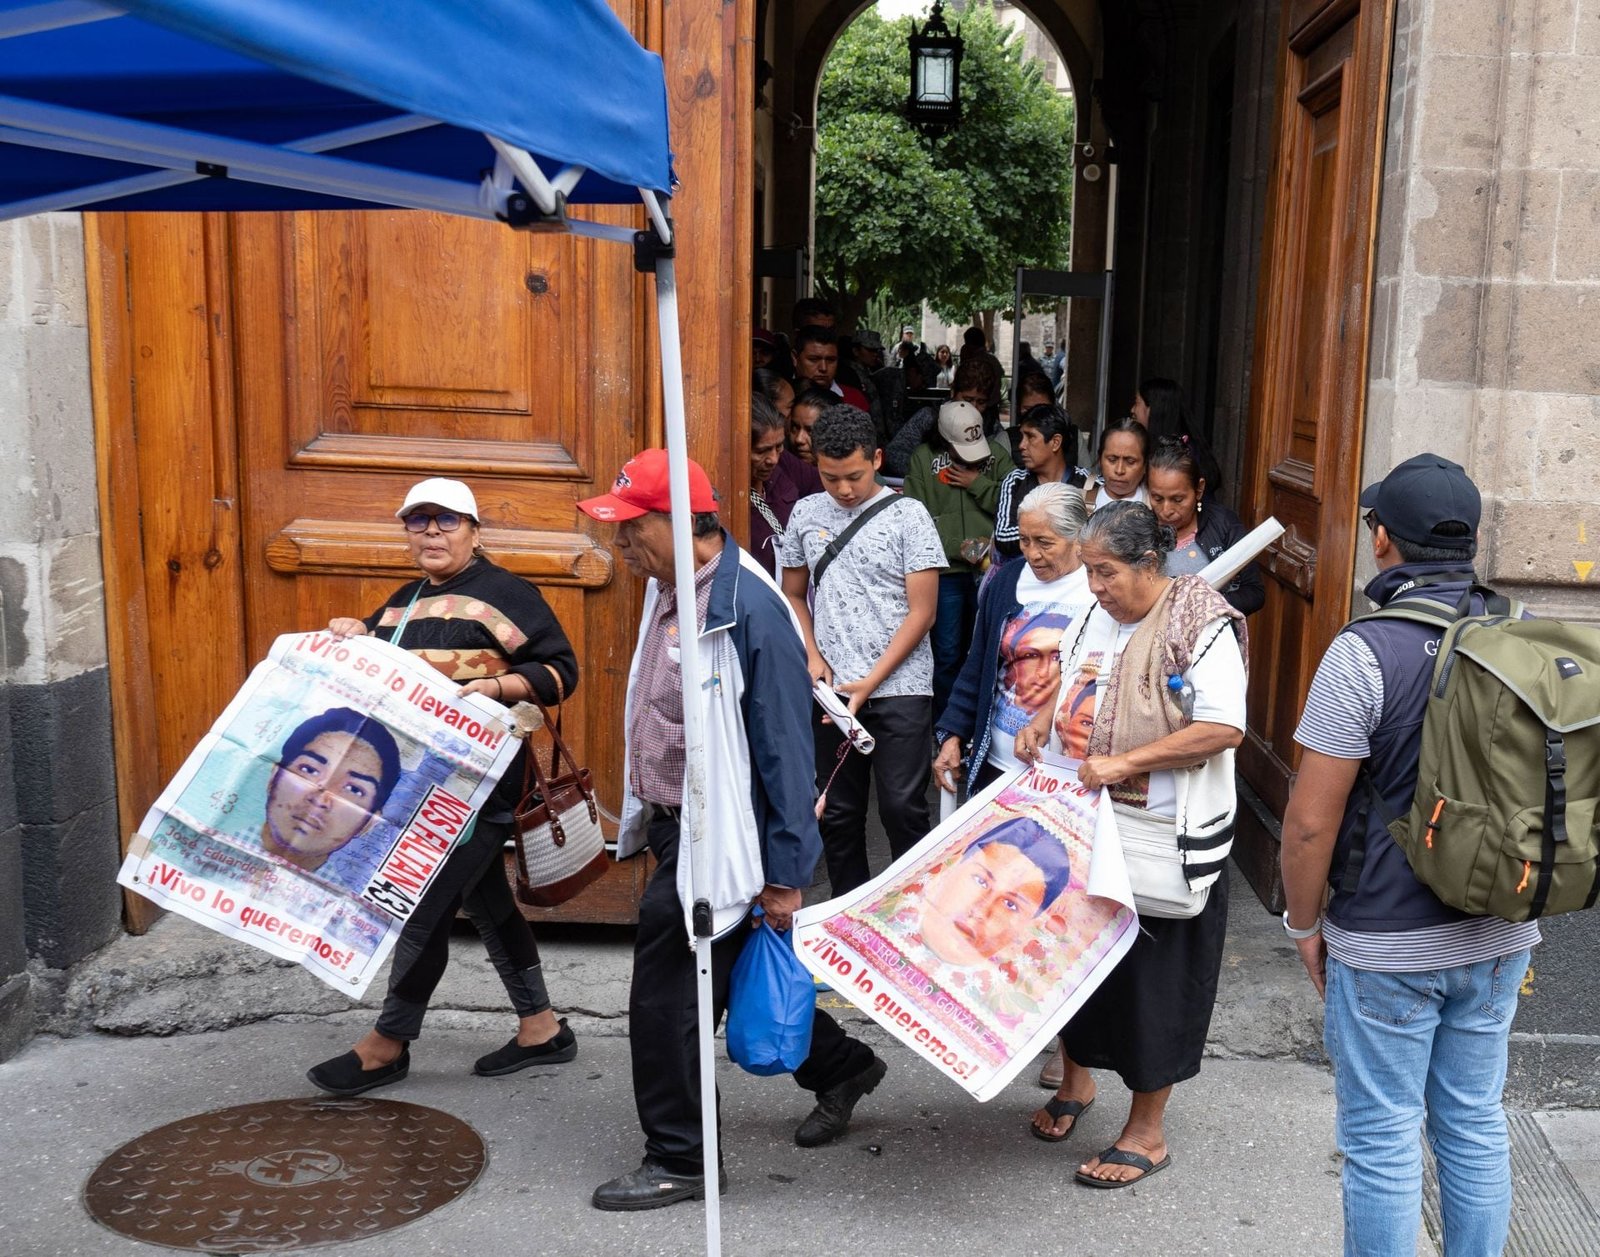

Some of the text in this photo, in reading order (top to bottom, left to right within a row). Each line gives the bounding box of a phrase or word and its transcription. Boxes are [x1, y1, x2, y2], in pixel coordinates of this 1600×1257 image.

[353, 657, 381, 677] se
[383, 669, 405, 692] lo
[407, 683, 505, 750] llevaron!
[210, 789, 239, 814] 43
[421, 787, 471, 834] NOS
[165, 825, 197, 849] José
[204, 846, 257, 875] Eduardo
[382, 822, 449, 895] FALTAN
[148, 863, 206, 901] ¡Vivo
[211, 889, 235, 913] lo
[240, 907, 355, 970] queremos!
[363, 879, 416, 922] 43!
[852, 968, 874, 994] lo
[873, 992, 980, 1080] queremos!
[877, 943, 933, 996] TRUJILLO
[935, 995, 998, 1047] GONZÁLEZ
